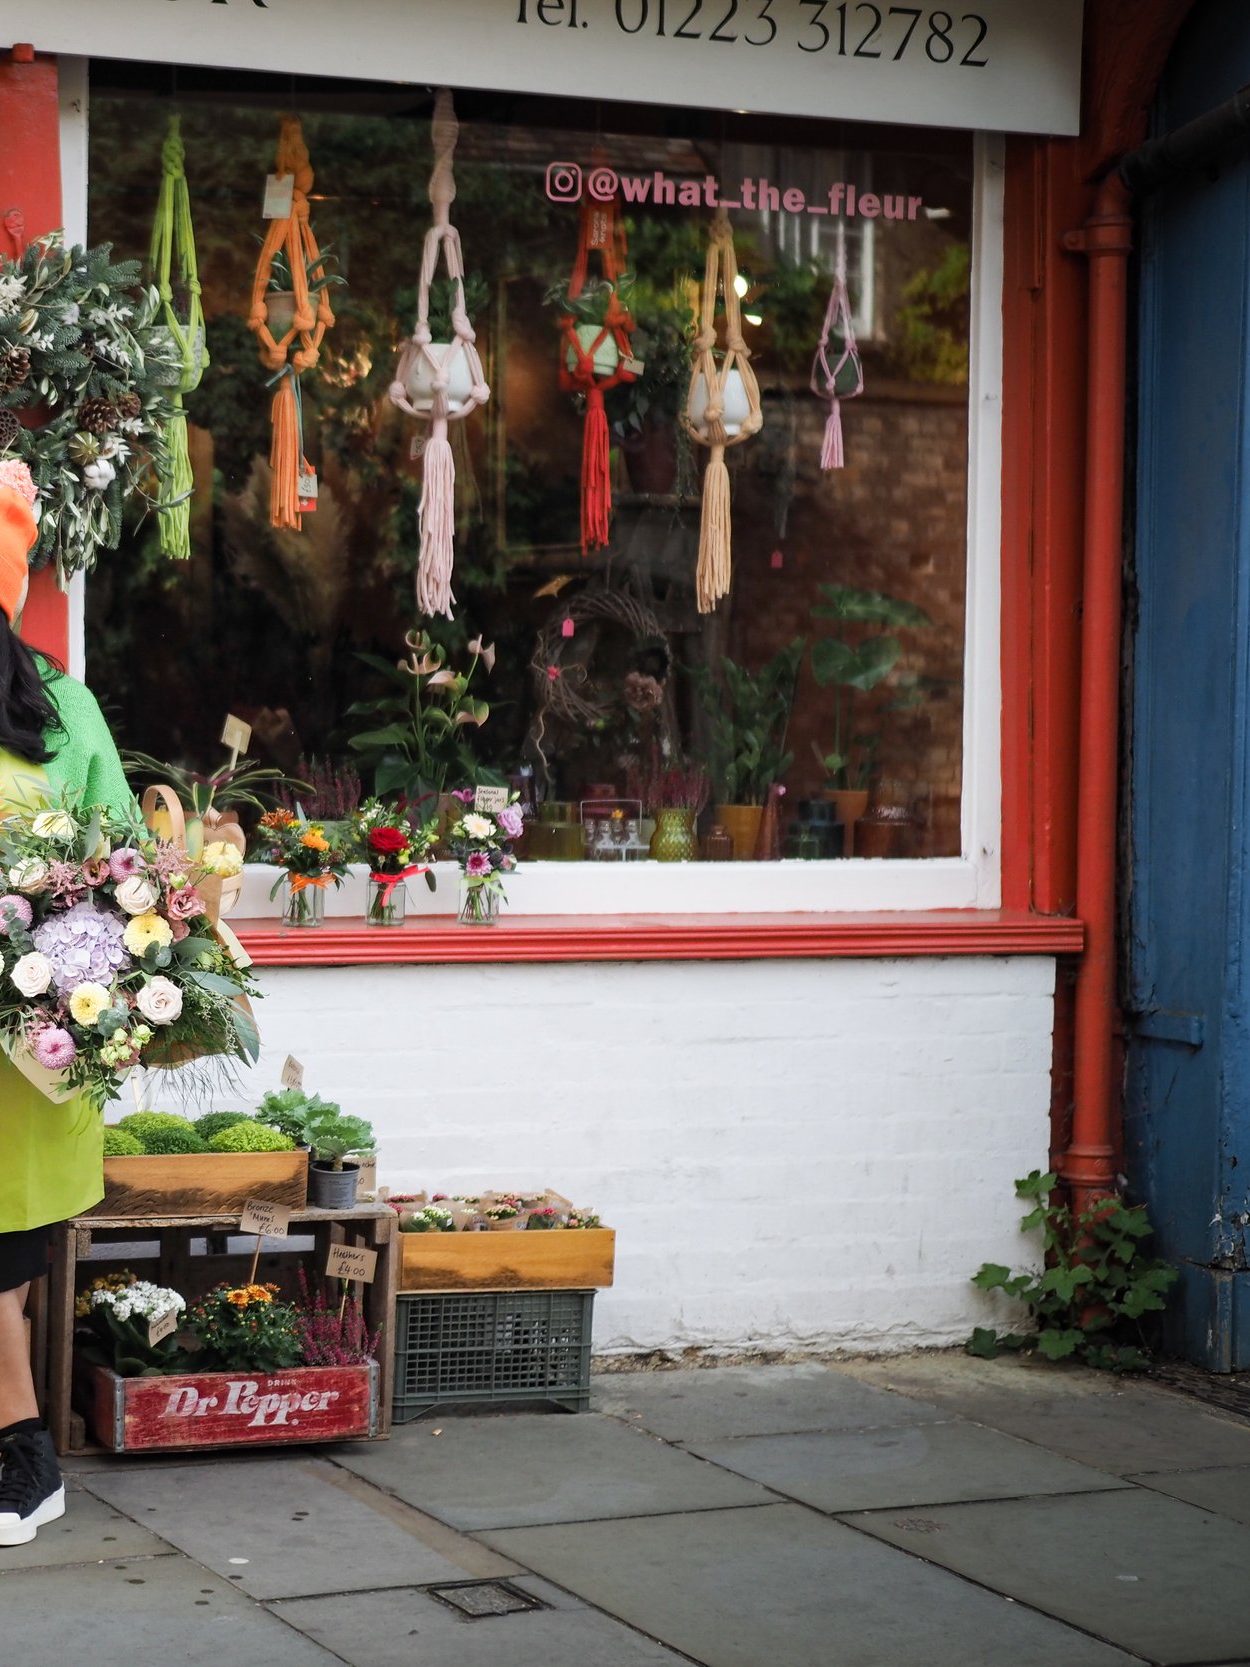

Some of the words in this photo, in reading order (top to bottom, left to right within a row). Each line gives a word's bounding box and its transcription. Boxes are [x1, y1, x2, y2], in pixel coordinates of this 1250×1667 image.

[614, 0, 777, 46] 01223
[797, 0, 989, 67] 312782
[588, 167, 922, 220] @what_the_fleur
[246, 1200, 274, 1214] Bronze
[157, 1386, 218, 1418] Dr
